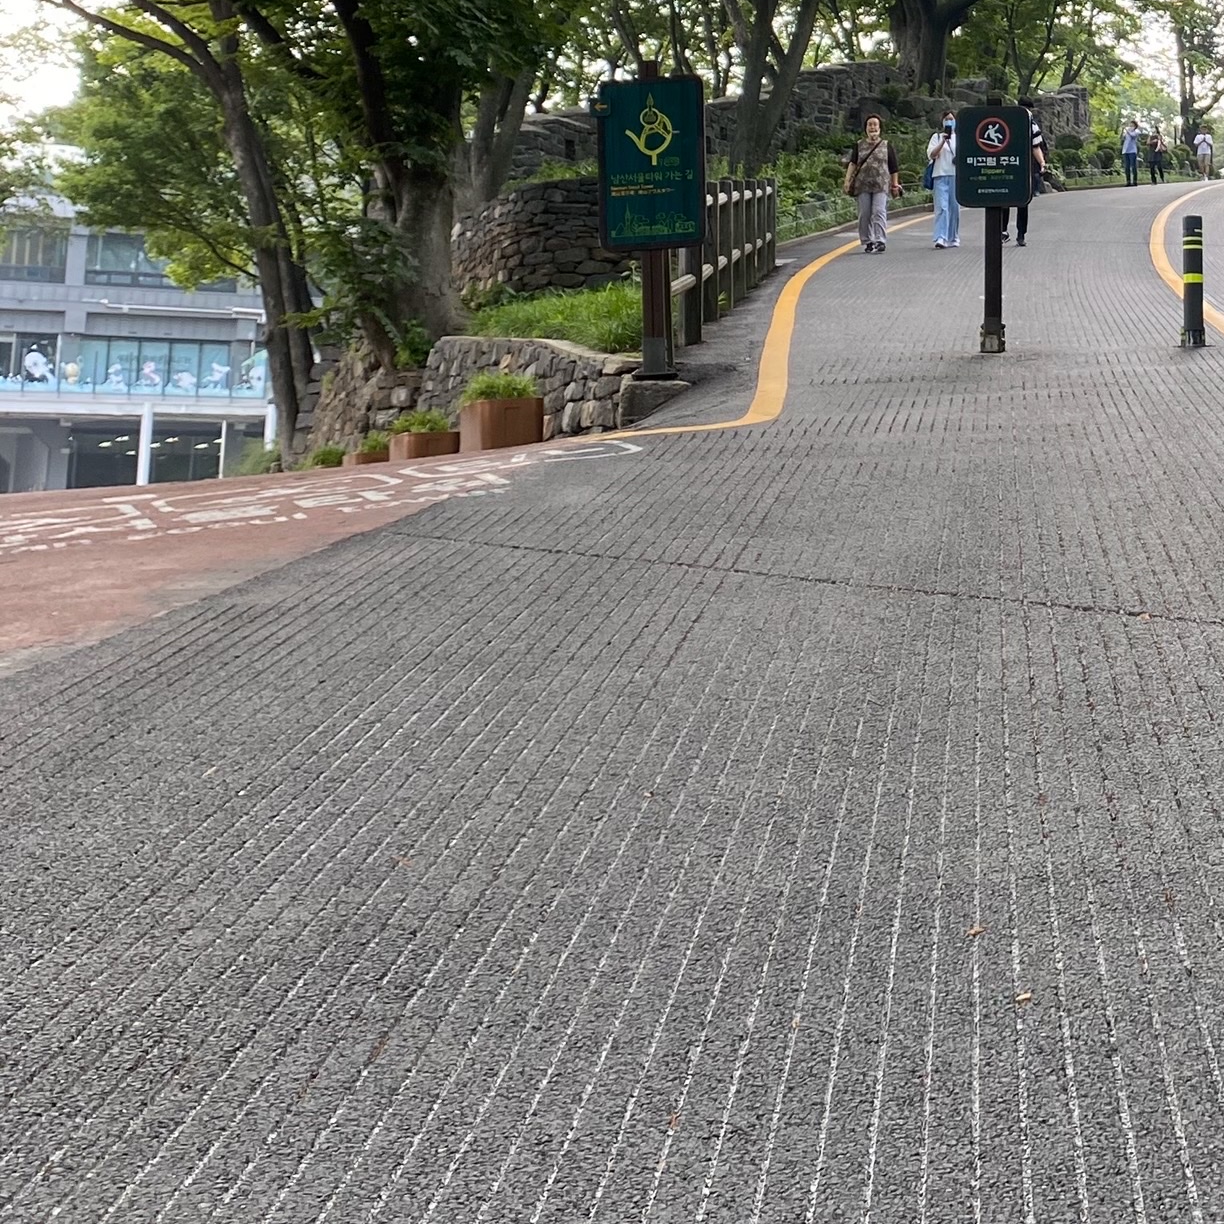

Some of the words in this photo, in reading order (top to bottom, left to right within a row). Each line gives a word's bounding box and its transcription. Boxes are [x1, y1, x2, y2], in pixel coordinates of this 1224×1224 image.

[966, 156, 997, 167] 미끄럼
[999, 155, 1020, 166] 주의
[610, 171, 663, 185] 남산서울타워
[665, 169, 683, 181] 가는
[685, 168, 694, 180] 길
